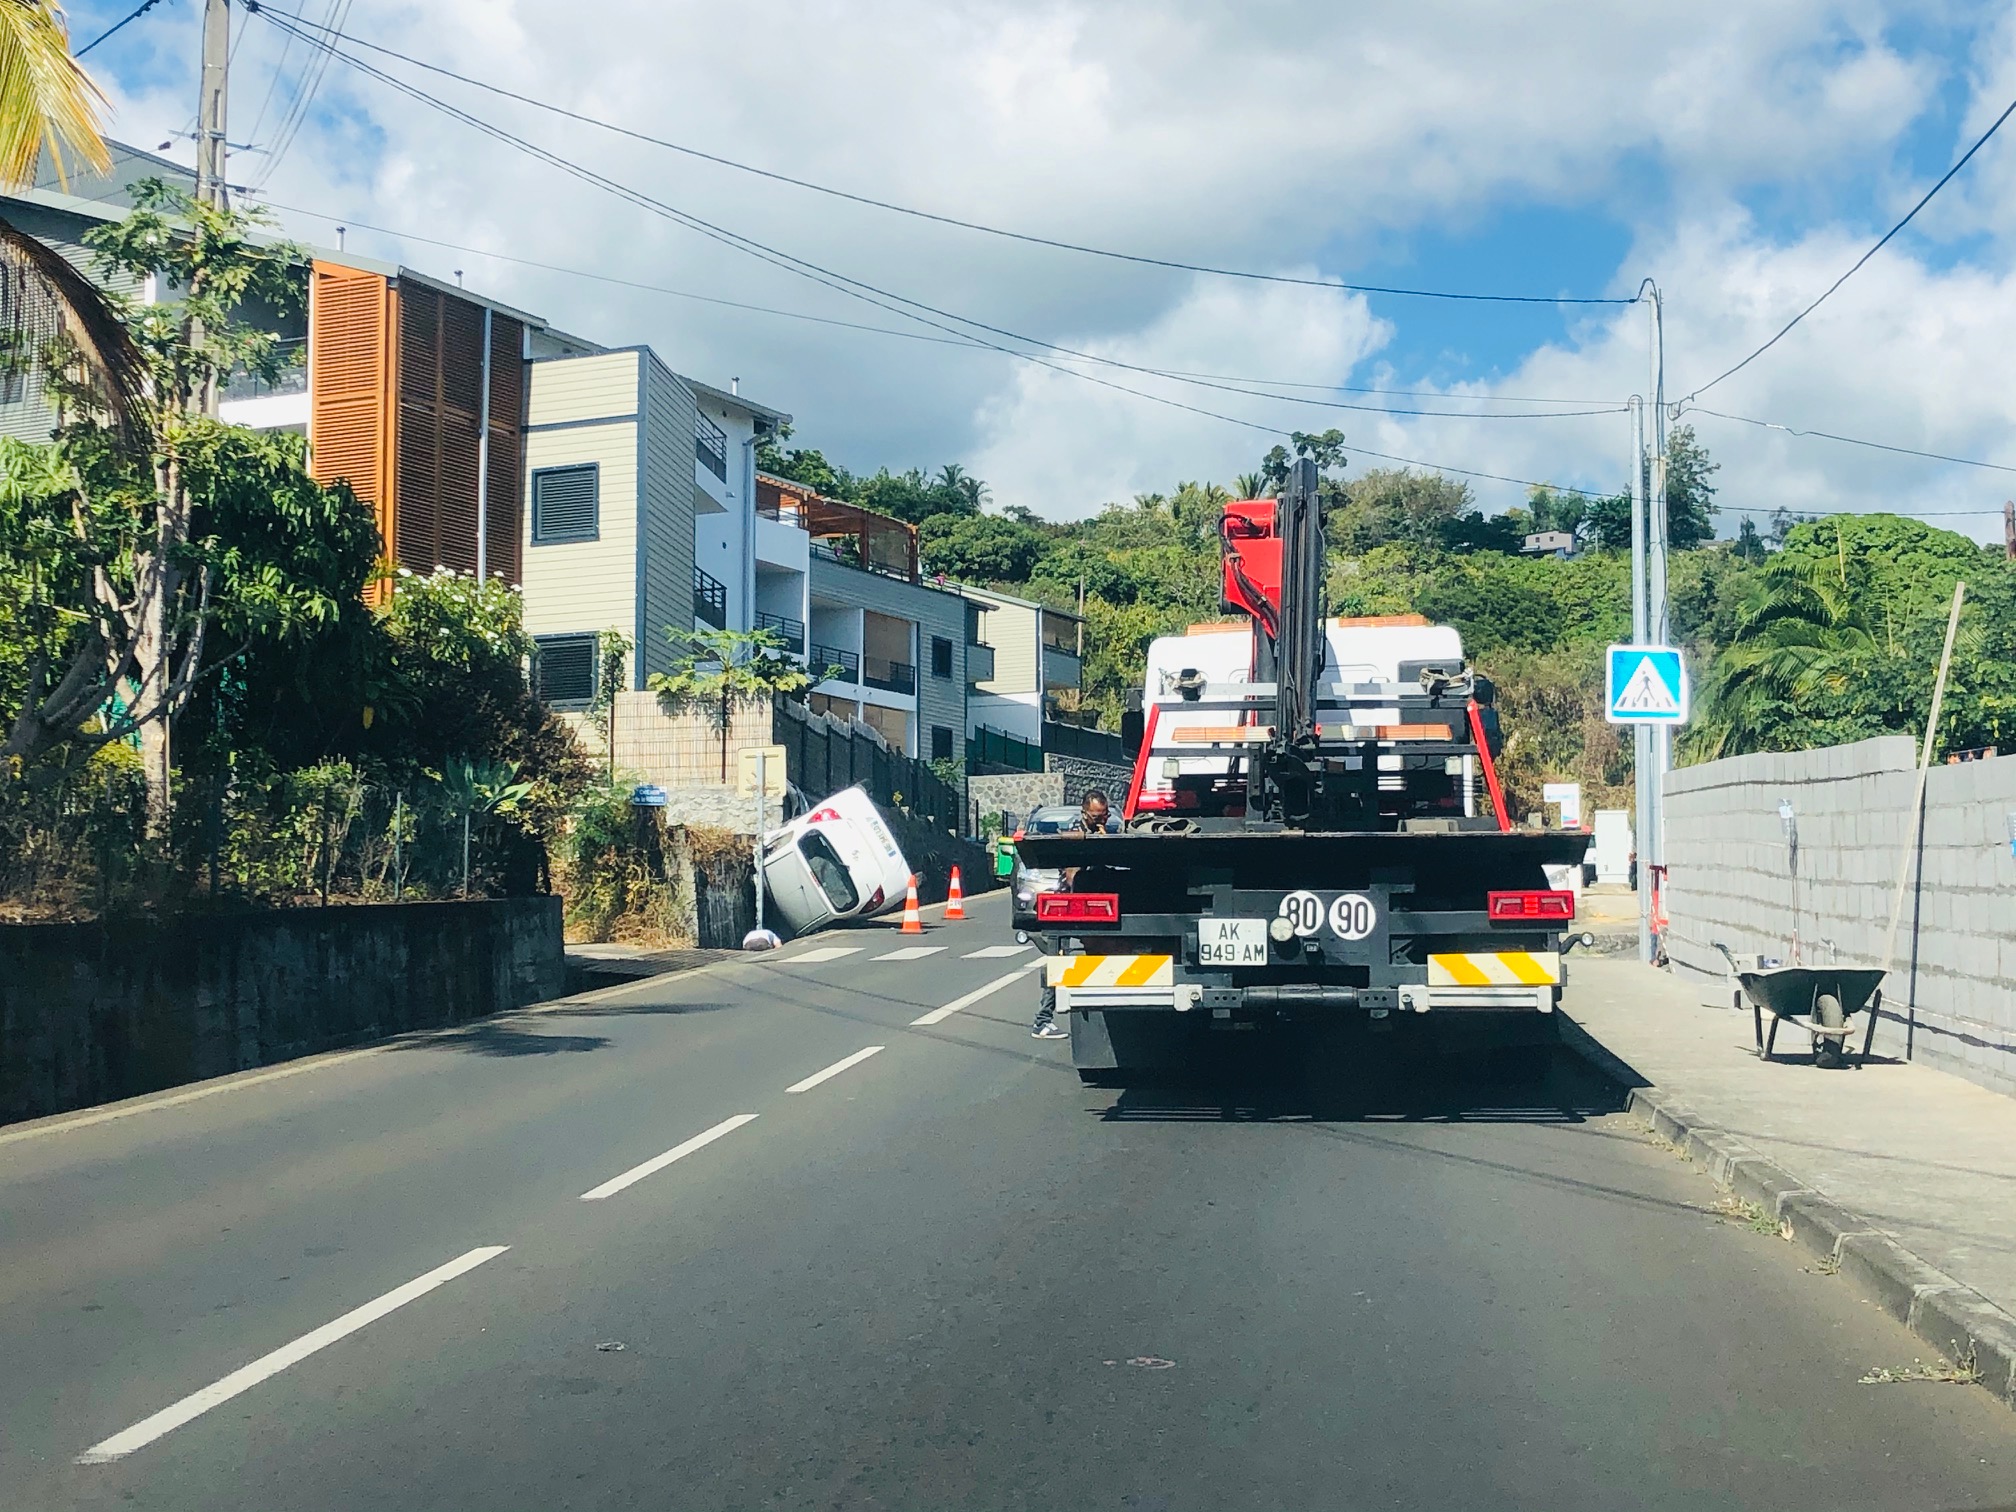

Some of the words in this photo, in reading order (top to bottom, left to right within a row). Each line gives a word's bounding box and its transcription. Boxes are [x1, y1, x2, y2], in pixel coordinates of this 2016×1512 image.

[1286, 897, 1317, 930] 80
[1337, 901, 1368, 934] 90
[1218, 922, 1240, 940] AK
[1201, 944, 1235, 961] 949
[1243, 944, 1264, 961] AM
